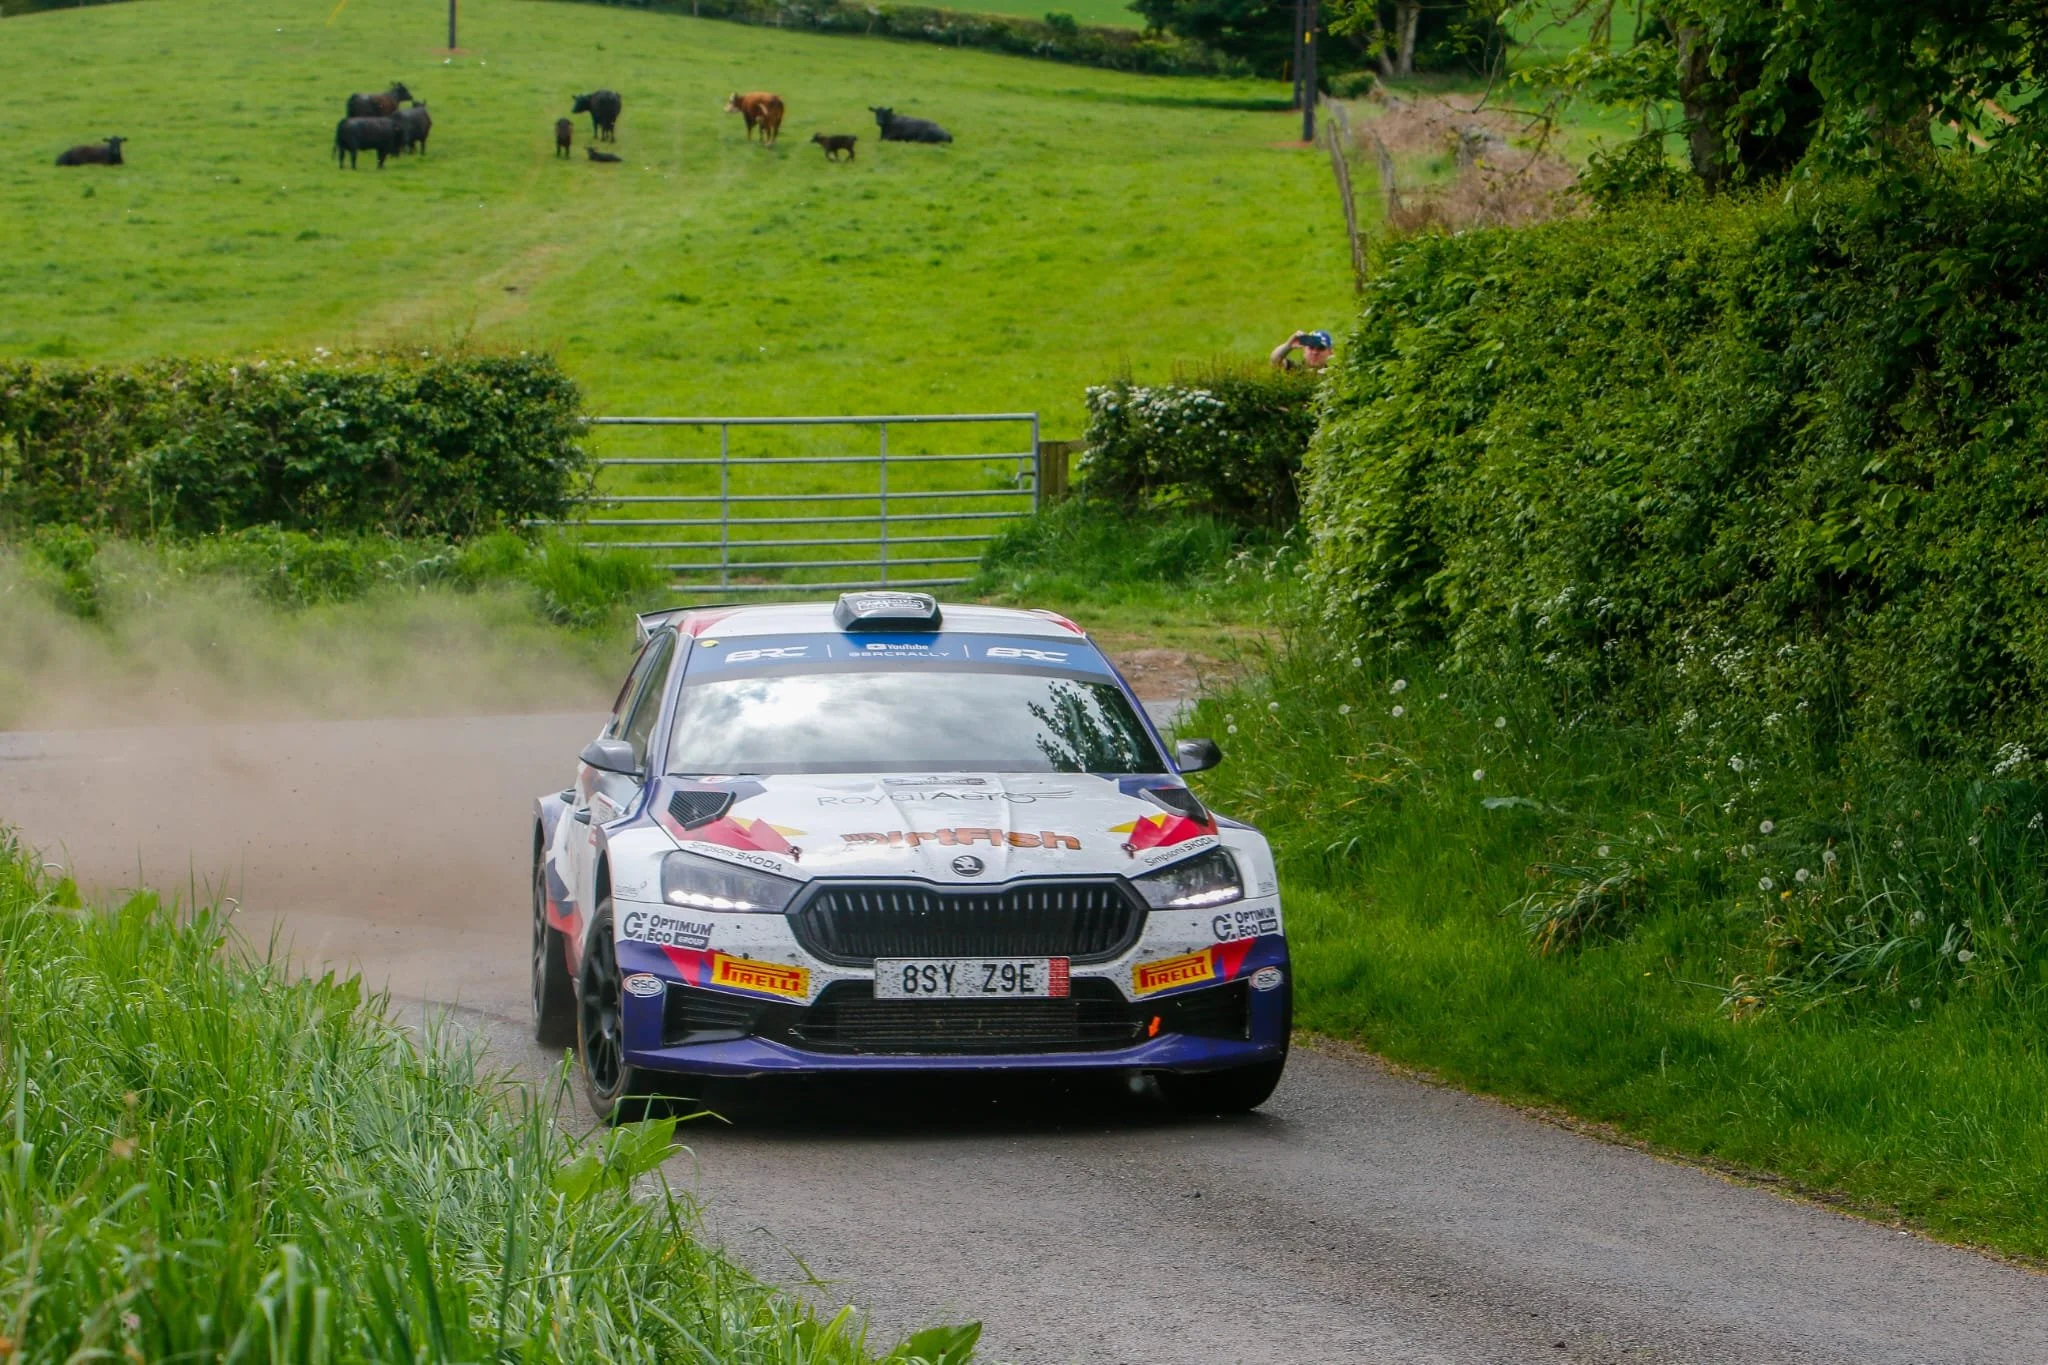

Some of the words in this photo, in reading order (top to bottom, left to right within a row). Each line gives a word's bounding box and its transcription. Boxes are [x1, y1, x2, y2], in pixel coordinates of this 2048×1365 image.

[886, 643, 929, 651] YouTube
[722, 961, 801, 992] PIRELLI
[902, 963, 956, 994] 8SY
[981, 963, 1036, 993] Z9E
[1140, 955, 1208, 988] PIRELLI
